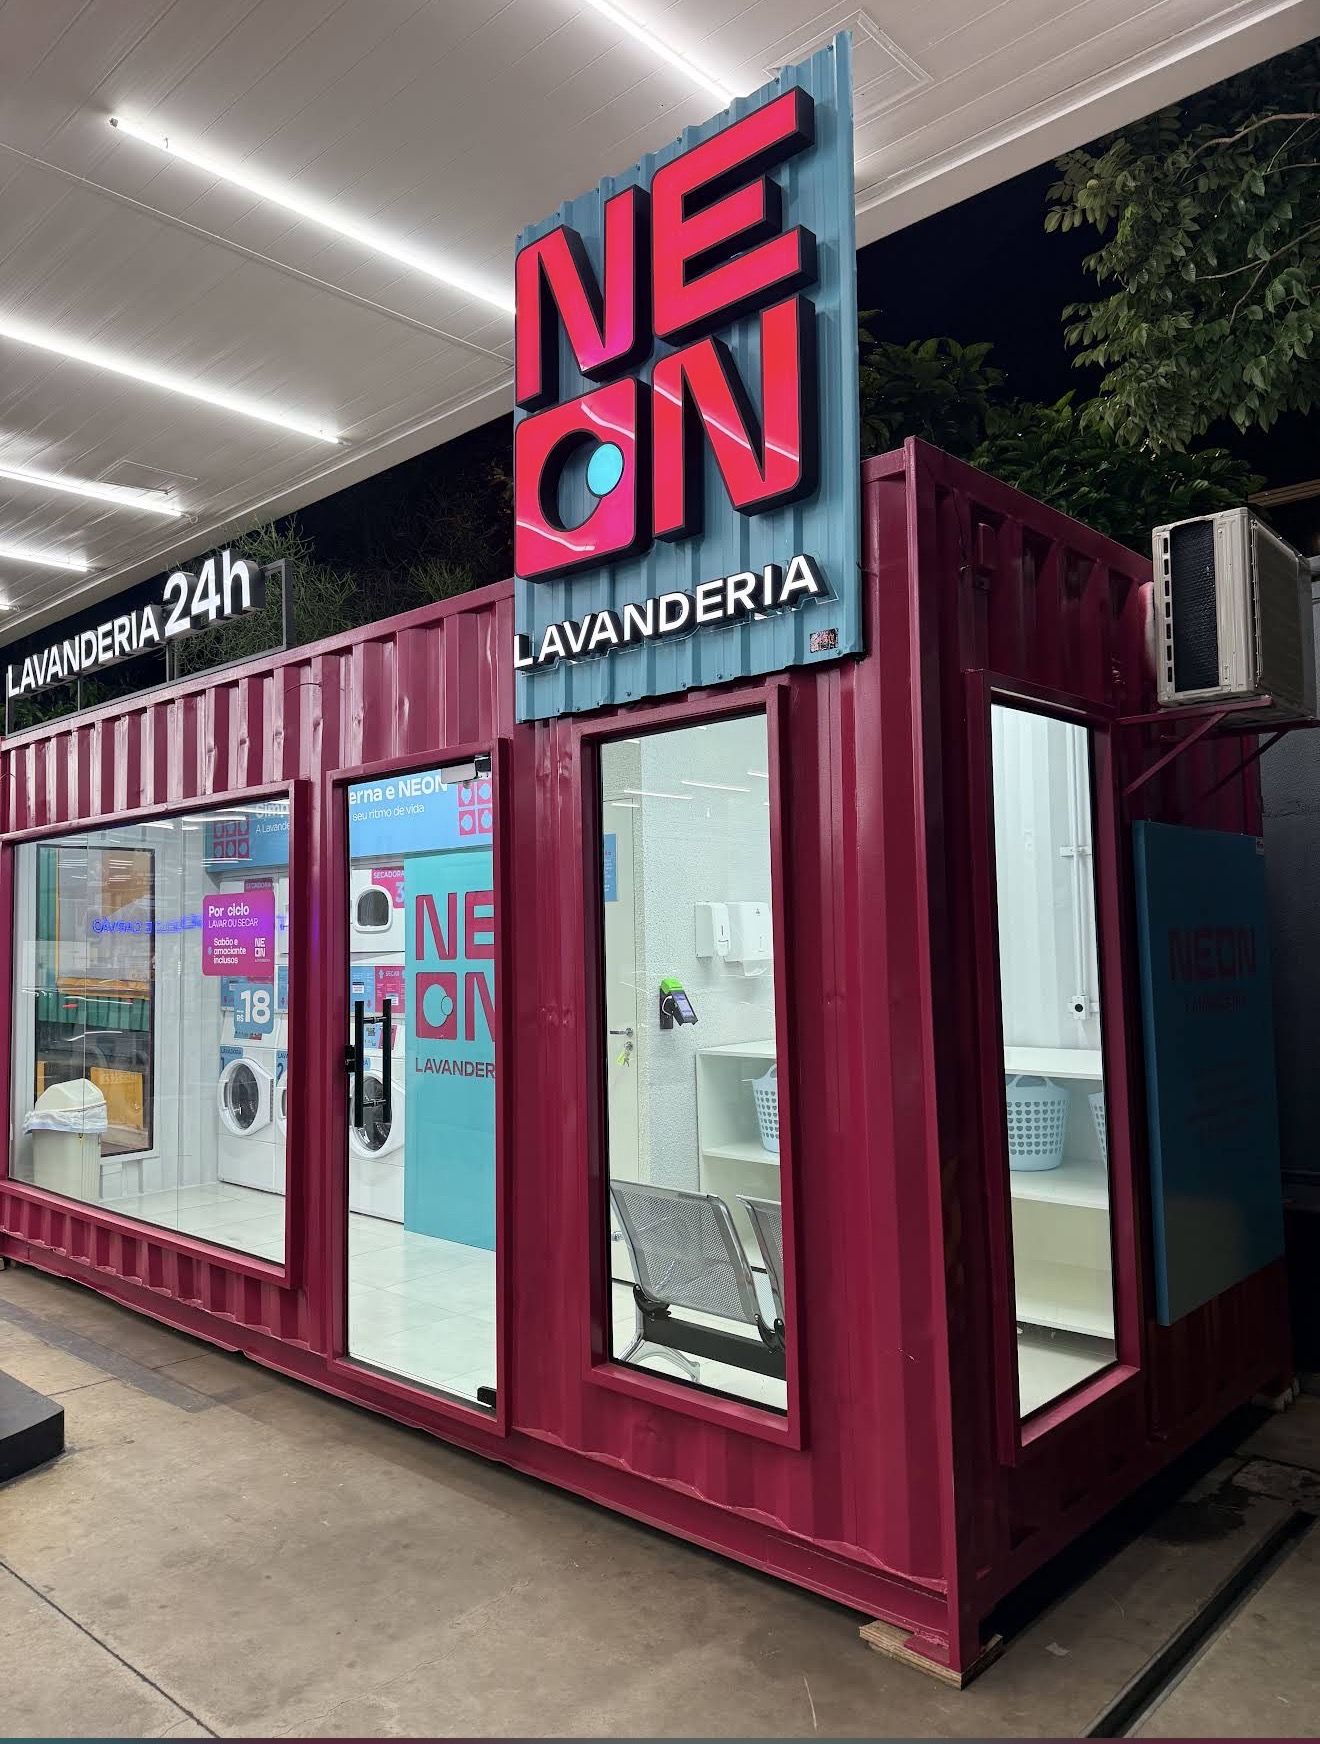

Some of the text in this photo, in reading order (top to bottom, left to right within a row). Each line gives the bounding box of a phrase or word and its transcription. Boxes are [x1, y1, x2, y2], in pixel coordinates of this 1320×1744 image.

[514, 554, 820, 670] LAVANDERIA
[8, 548, 252, 698] LAVANDERIA 24h
[386, 785, 395, 799] e
[398, 775, 448, 798] NEON
[353, 803, 425, 822] seu ritmo de vida
[208, 902, 250, 918] Por ciclo
[208, 919, 227, 928] LAVAR
[227, 918, 237, 927] OU
[237, 917, 259, 927] SECAR
[213, 937, 239, 946] Sabão e
[213, 946, 247, 955] amaciante
[213, 956, 239, 964] inclusos
[240, 989, 271, 1024] 18
